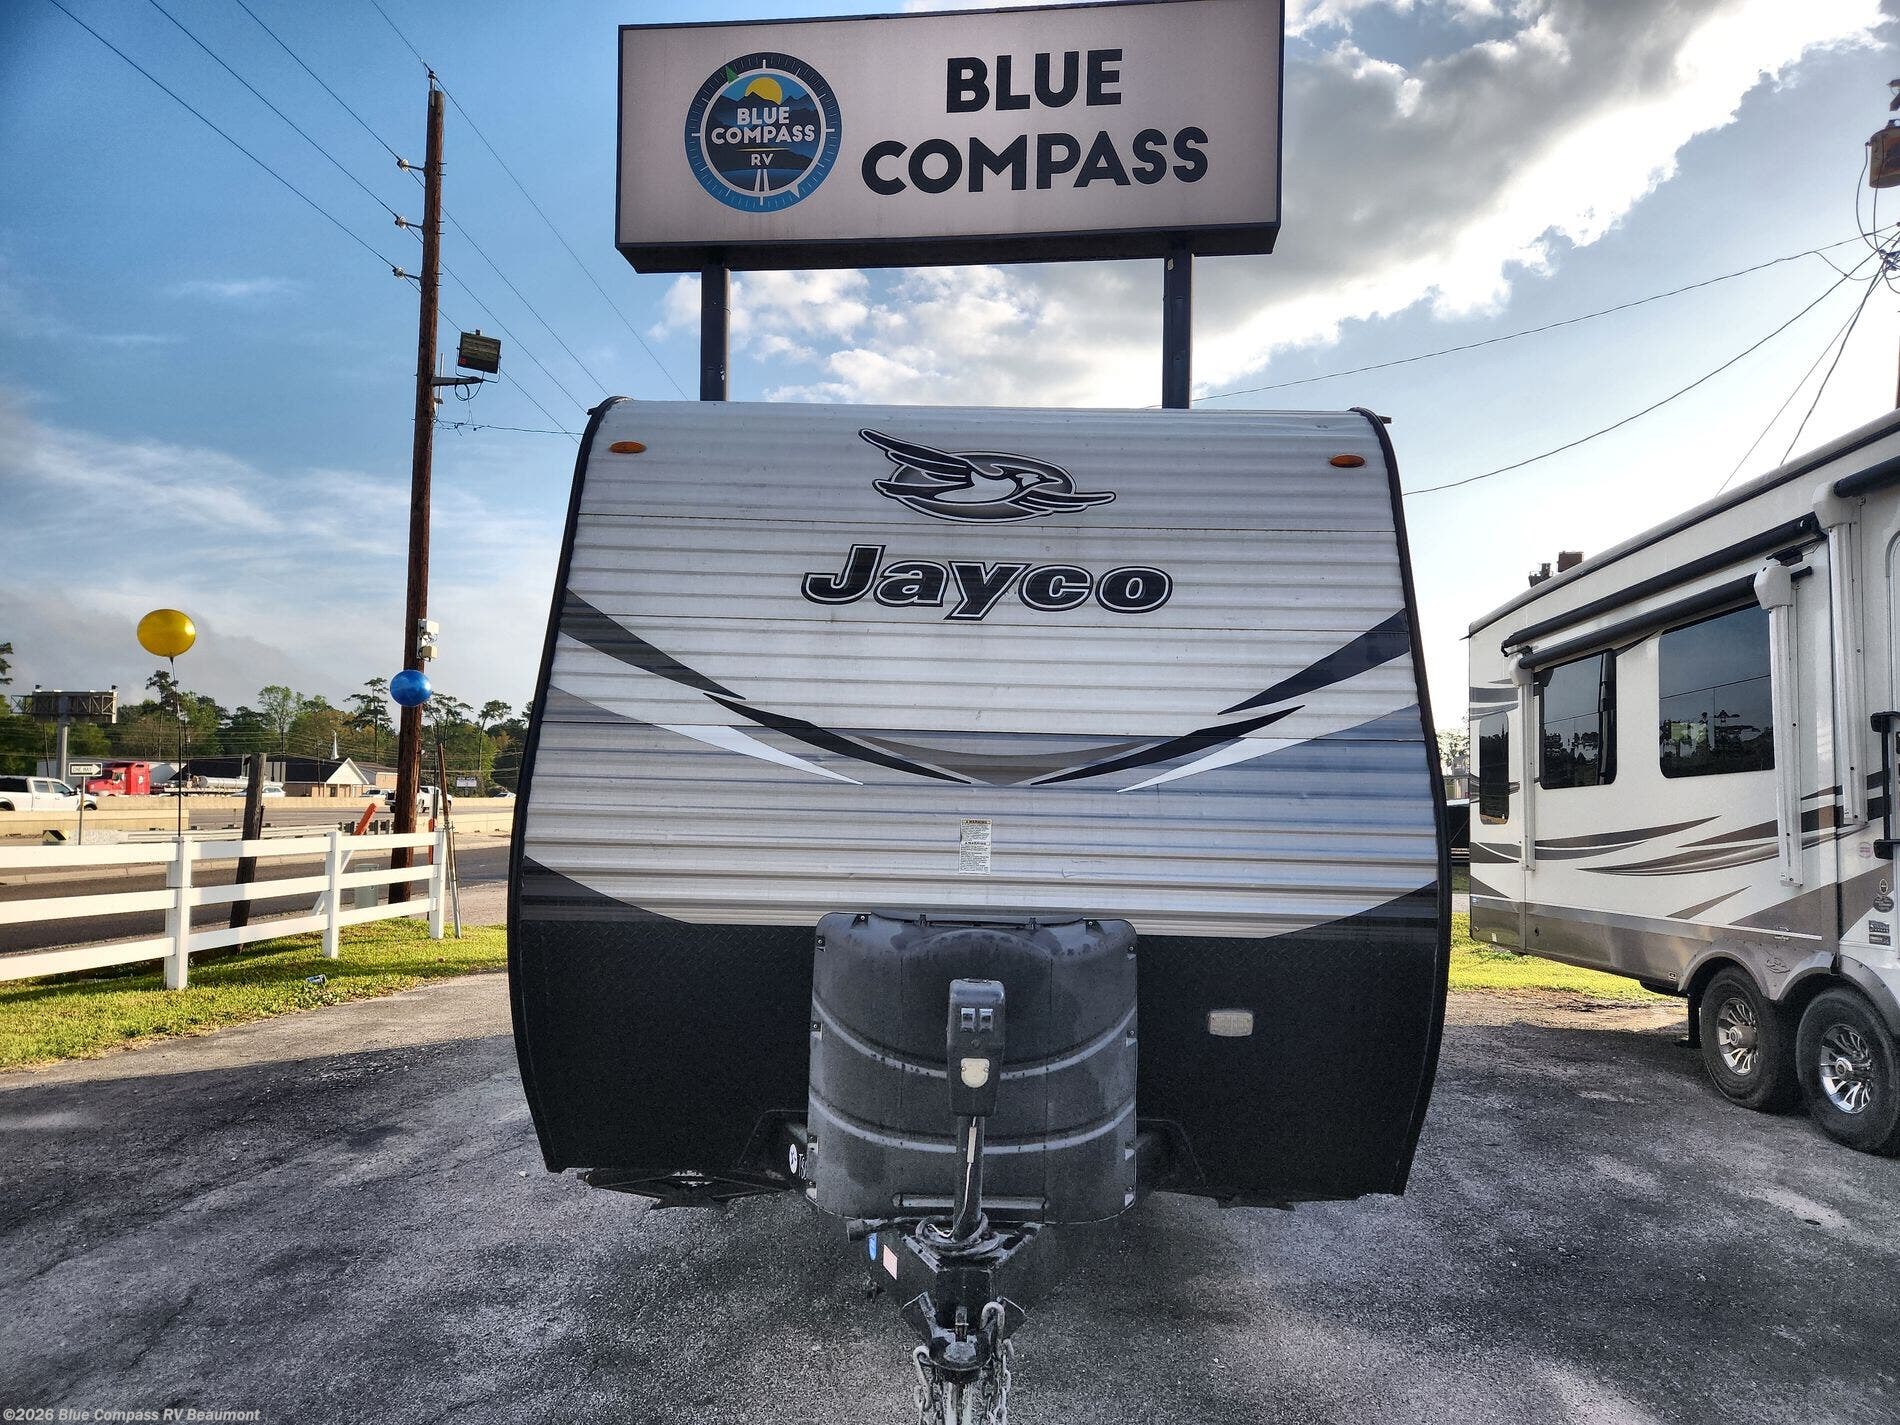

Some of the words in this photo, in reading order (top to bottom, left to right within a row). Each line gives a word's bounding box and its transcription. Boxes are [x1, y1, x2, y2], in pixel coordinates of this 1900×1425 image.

[946, 48, 1123, 114] BLUE
[711, 124, 816, 145] COMPASS
[736, 106, 790, 126] BLUE
[751, 153, 774, 166] RV
[861, 126, 1209, 196] COMPASS
[801, 543, 1174, 621] Jayco
